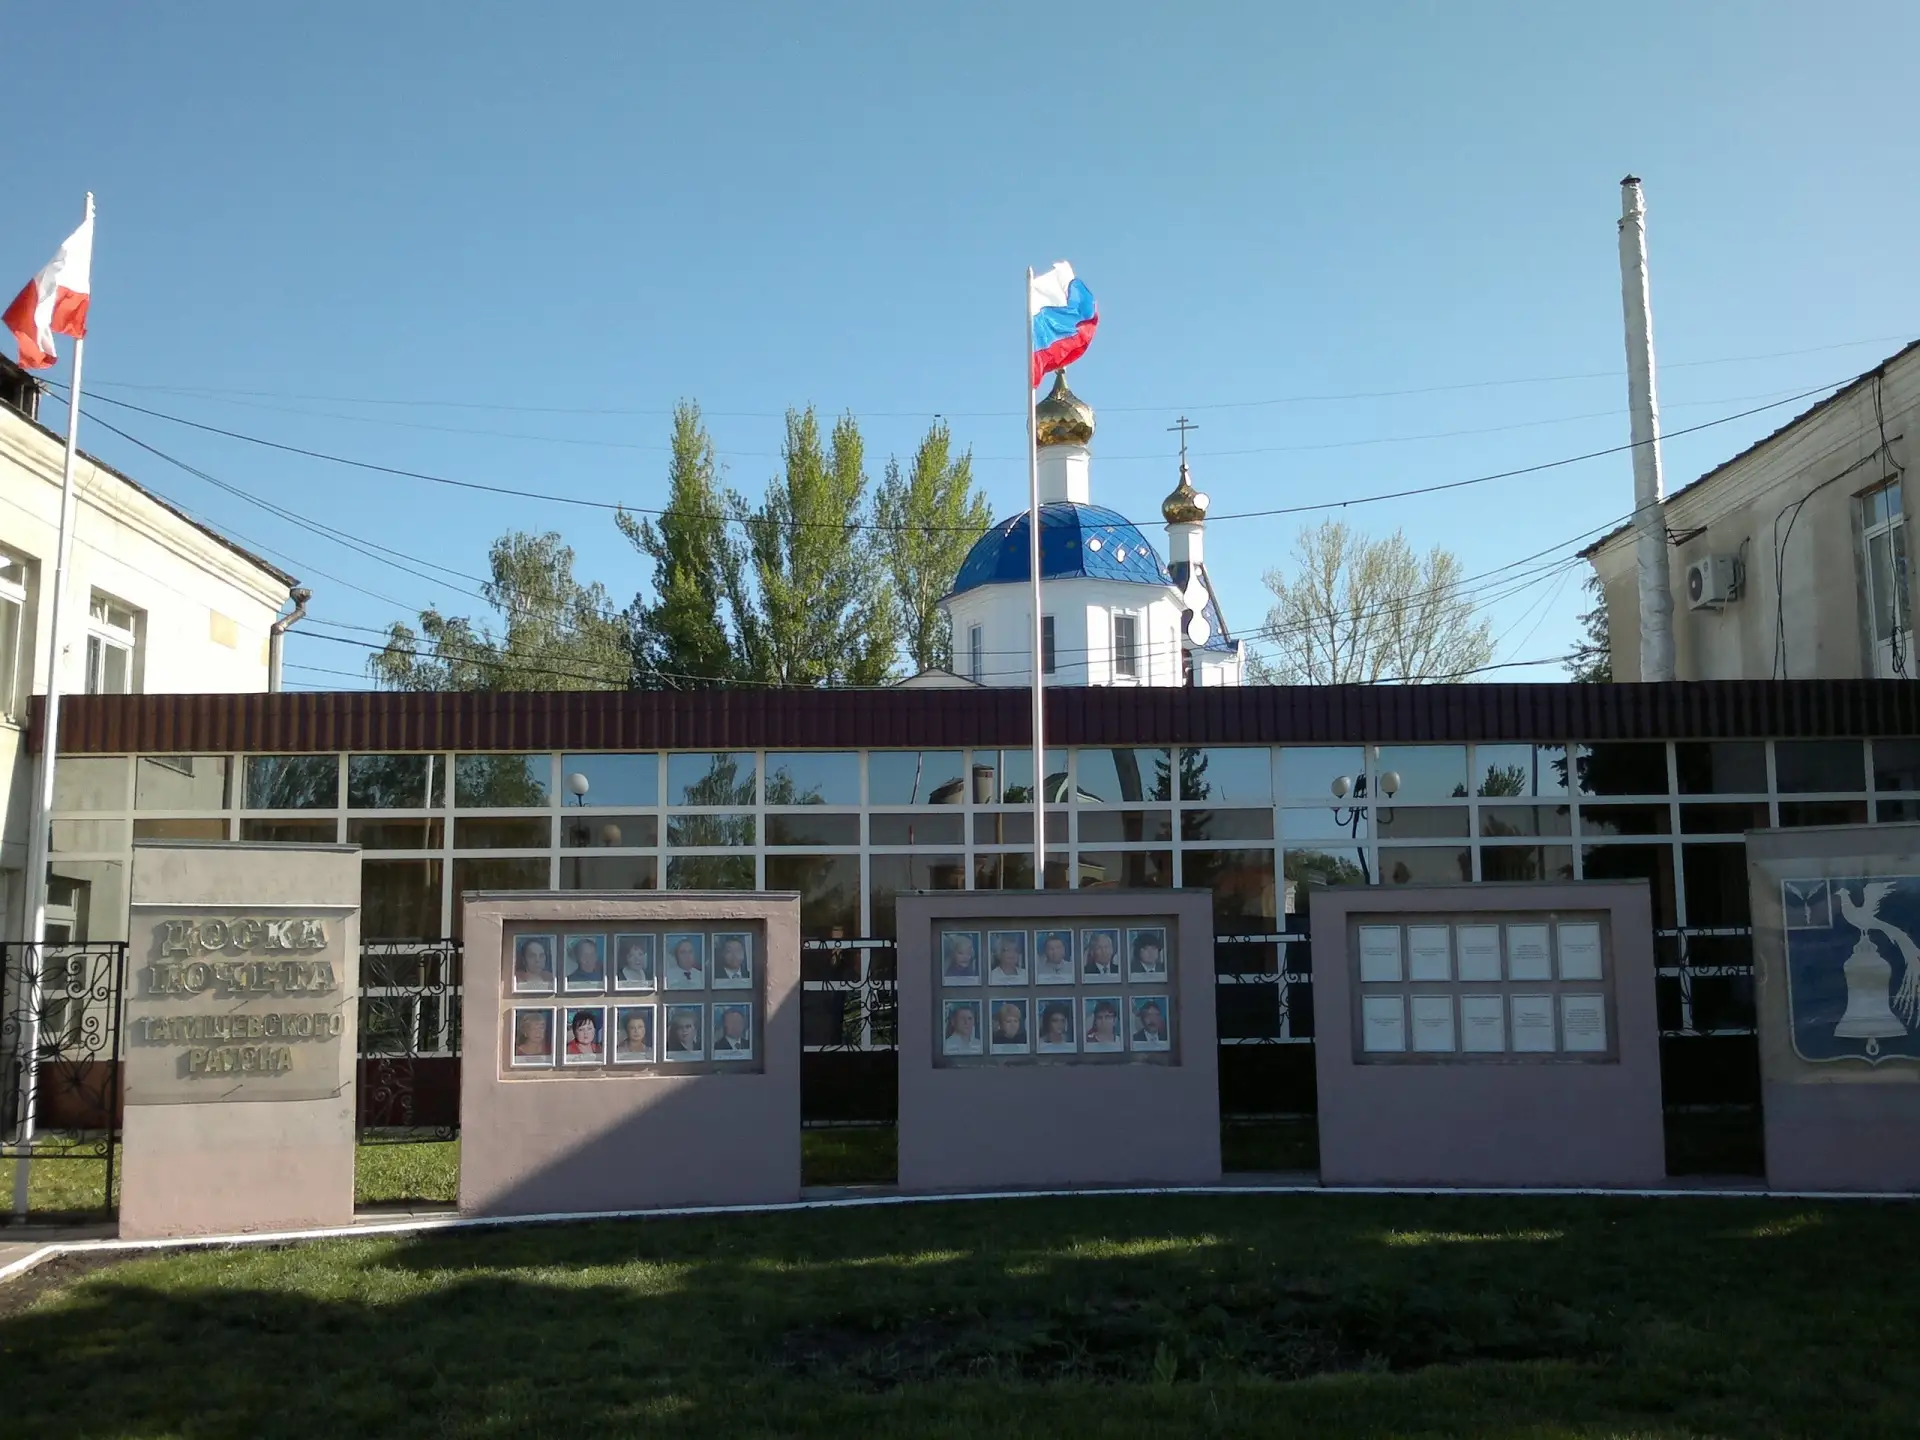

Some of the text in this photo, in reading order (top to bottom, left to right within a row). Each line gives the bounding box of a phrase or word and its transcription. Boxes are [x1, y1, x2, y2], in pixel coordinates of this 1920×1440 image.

[161, 918, 329, 957] ДОСКА
[148, 960, 338, 994] ПОЧЕТА
[140, 1012, 345, 1042] ТАТИЩЕВСКОГО
